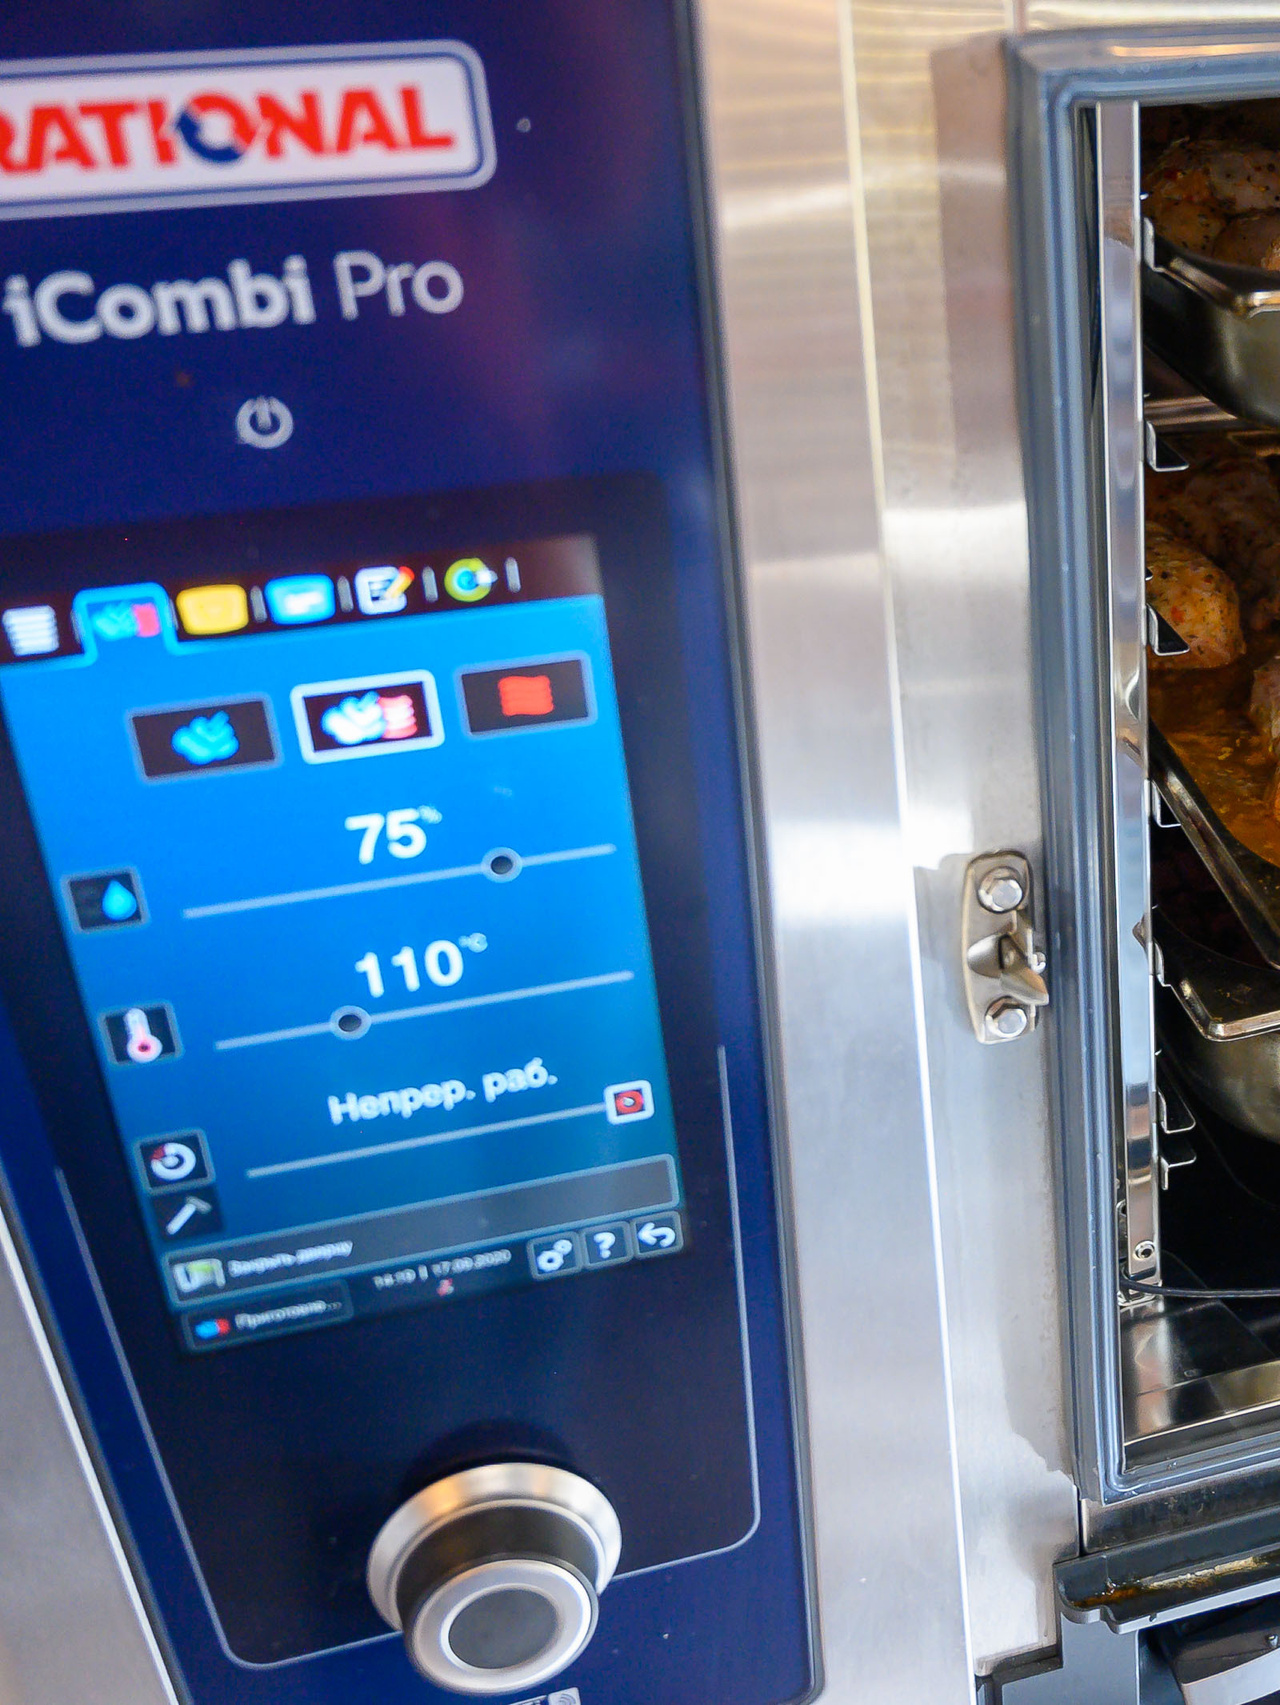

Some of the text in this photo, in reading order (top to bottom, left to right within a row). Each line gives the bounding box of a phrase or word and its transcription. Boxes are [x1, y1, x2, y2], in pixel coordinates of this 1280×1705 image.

[2, 249, 465, 347] iCombi Pro
[482, 1056, 559, 1104] раб.
